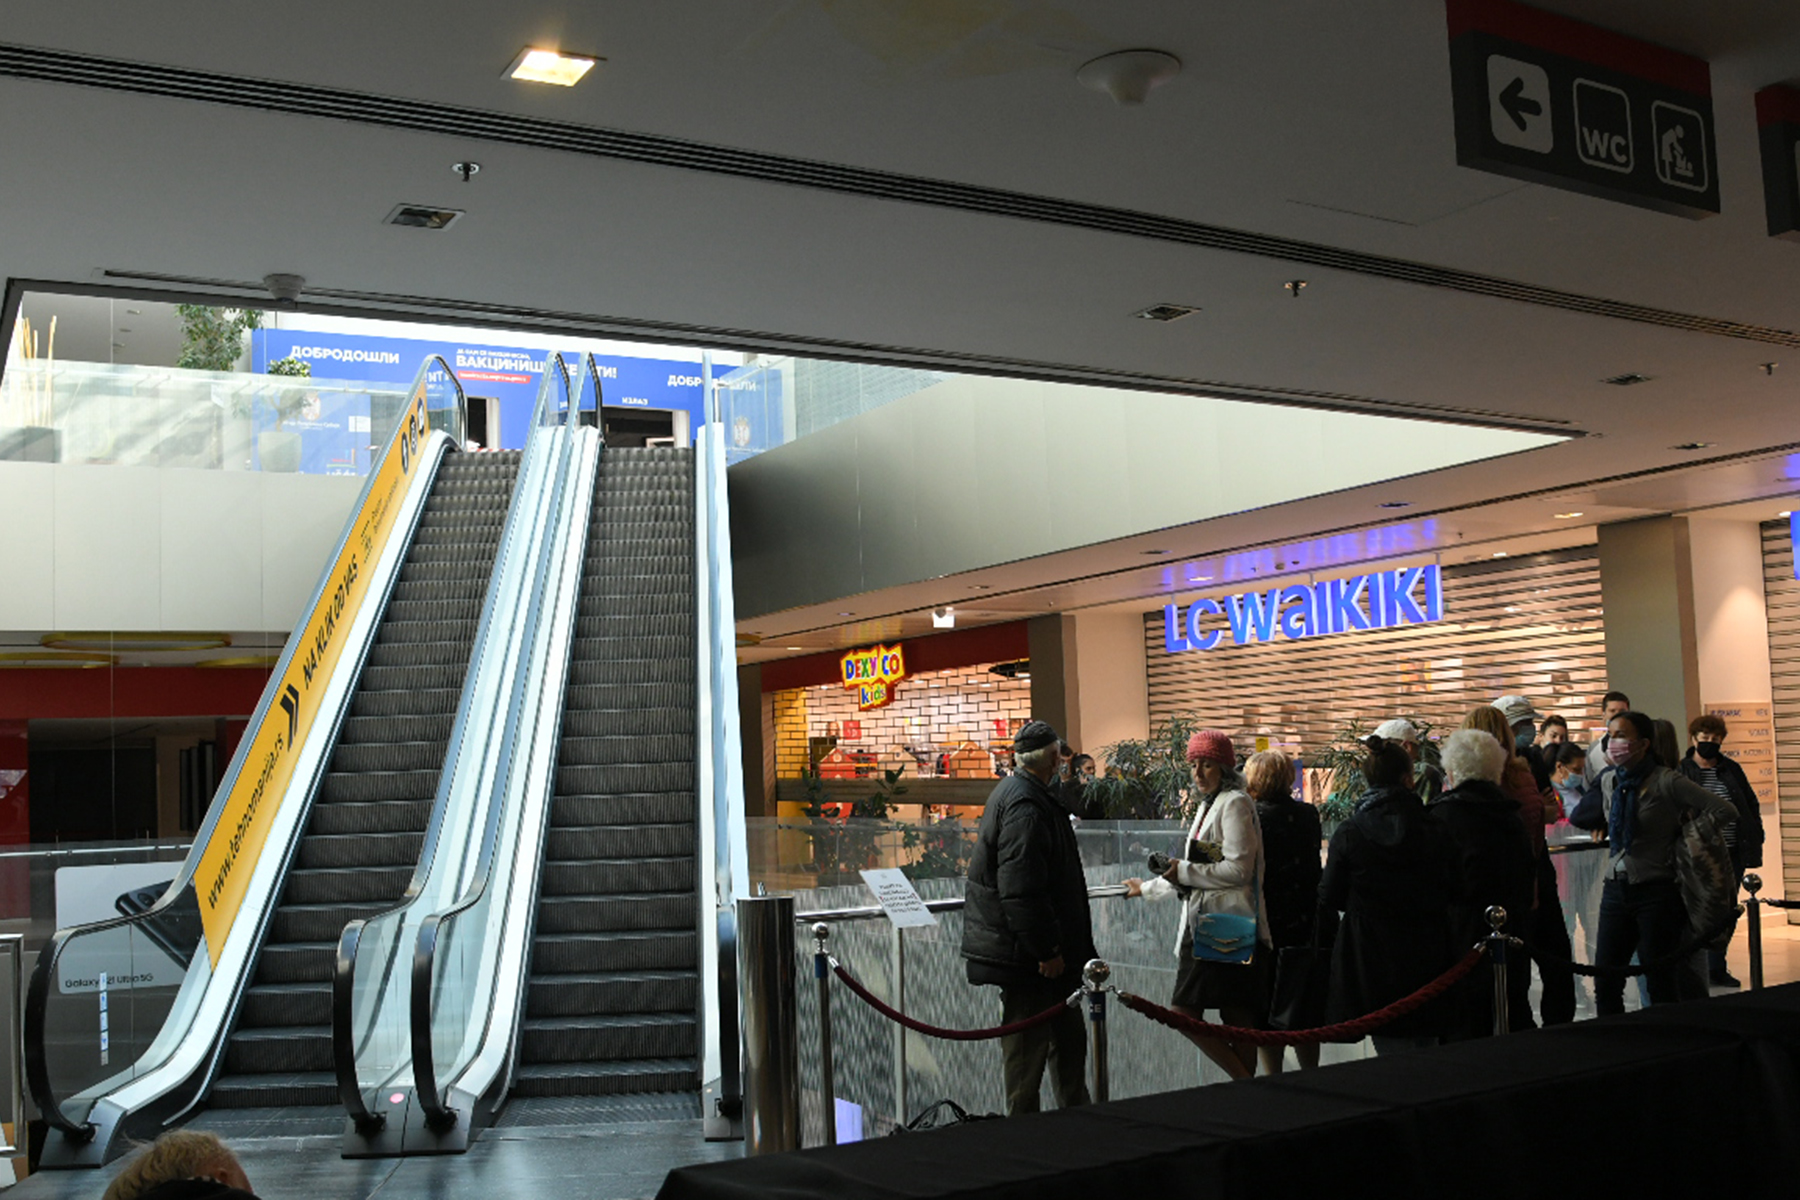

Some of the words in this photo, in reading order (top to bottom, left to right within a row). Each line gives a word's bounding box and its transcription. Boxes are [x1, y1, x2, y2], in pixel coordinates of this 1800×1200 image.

[1582, 126, 1627, 163] WC
[290, 345, 400, 364] ДОБРОДОШЛИ
[456, 355, 544, 373] ВАКЦИНИШ
[667, 374, 757, 391] ДОБРДШЛИ
[845, 657, 878, 680] DEXY
[882, 652, 900, 676] CO
[861, 684, 887, 705] kids
[208, 732, 285, 910] www.tehnomanija.rs
[302, 646, 318, 691] NA
[315, 605, 336, 662] KLIK
[343, 552, 359, 597] VAS
[65, 978, 99, 989] Galaxy
